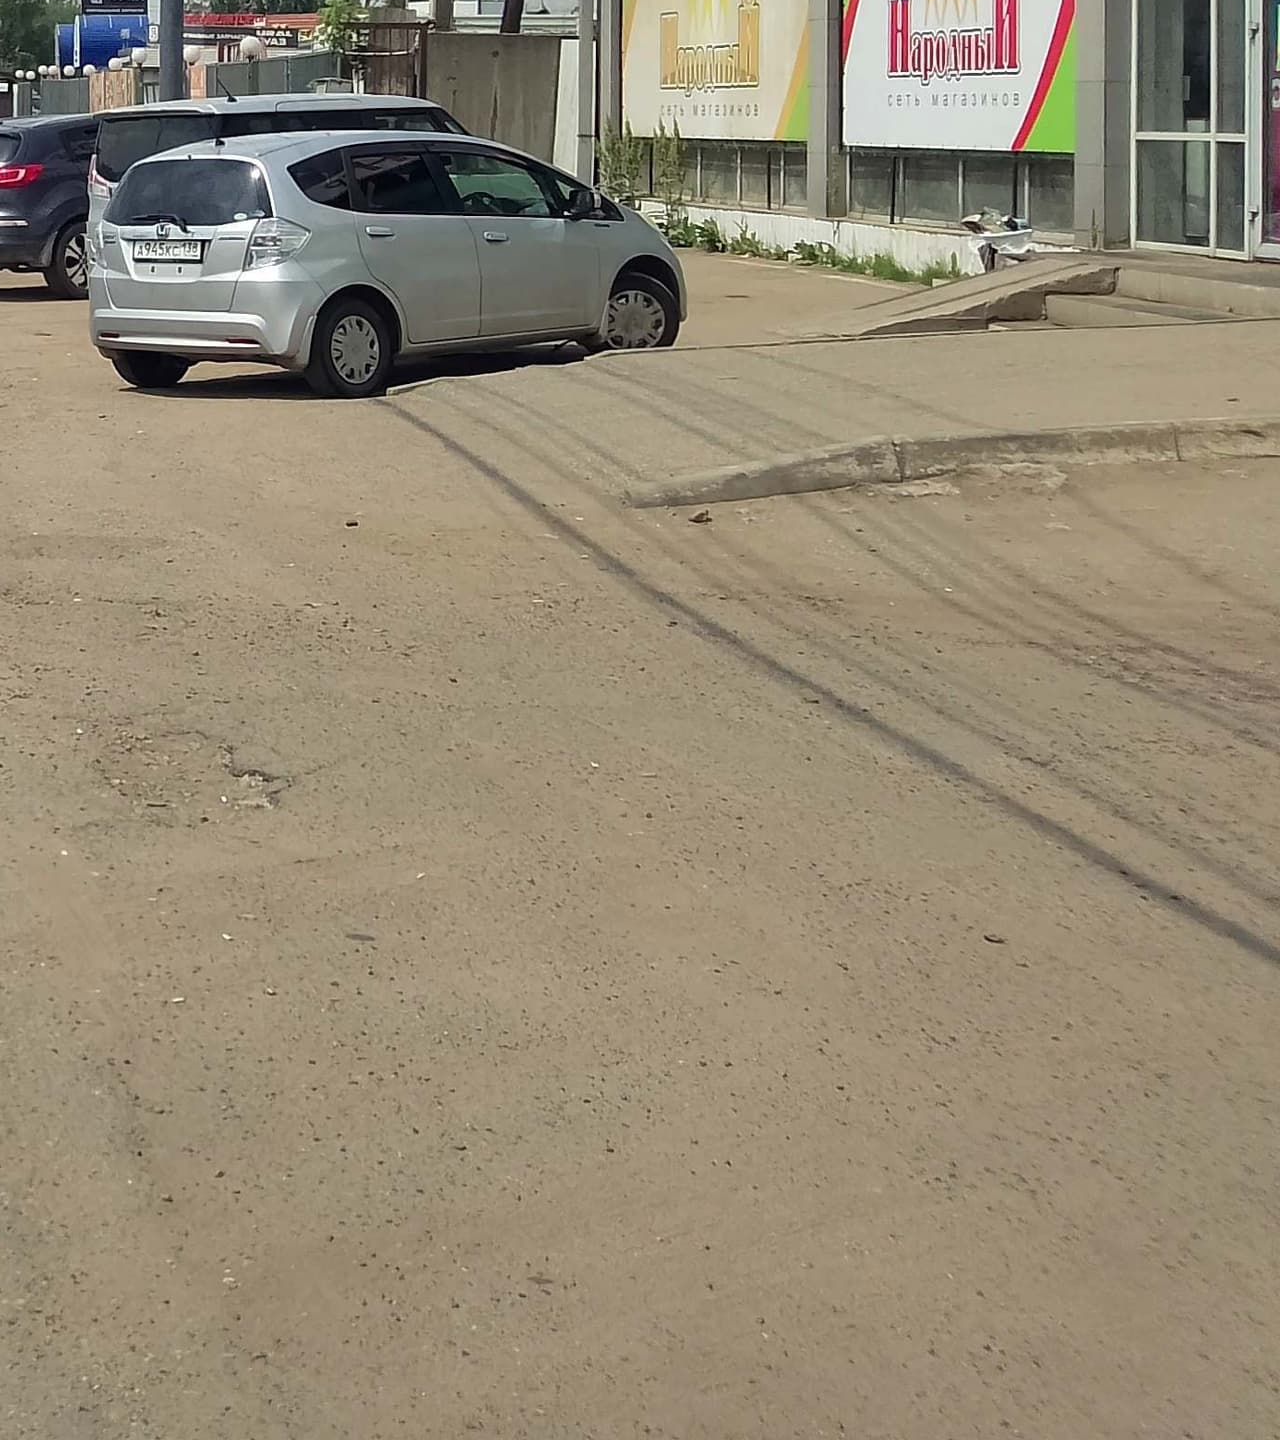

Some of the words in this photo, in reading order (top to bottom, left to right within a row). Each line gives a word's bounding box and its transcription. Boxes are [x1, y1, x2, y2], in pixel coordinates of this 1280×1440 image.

[888, 93, 920, 107] сеть
[932, 92, 1020, 108] магазинов
[660, 104, 684, 117] сеть
[693, 104, 758, 118] магазинов
